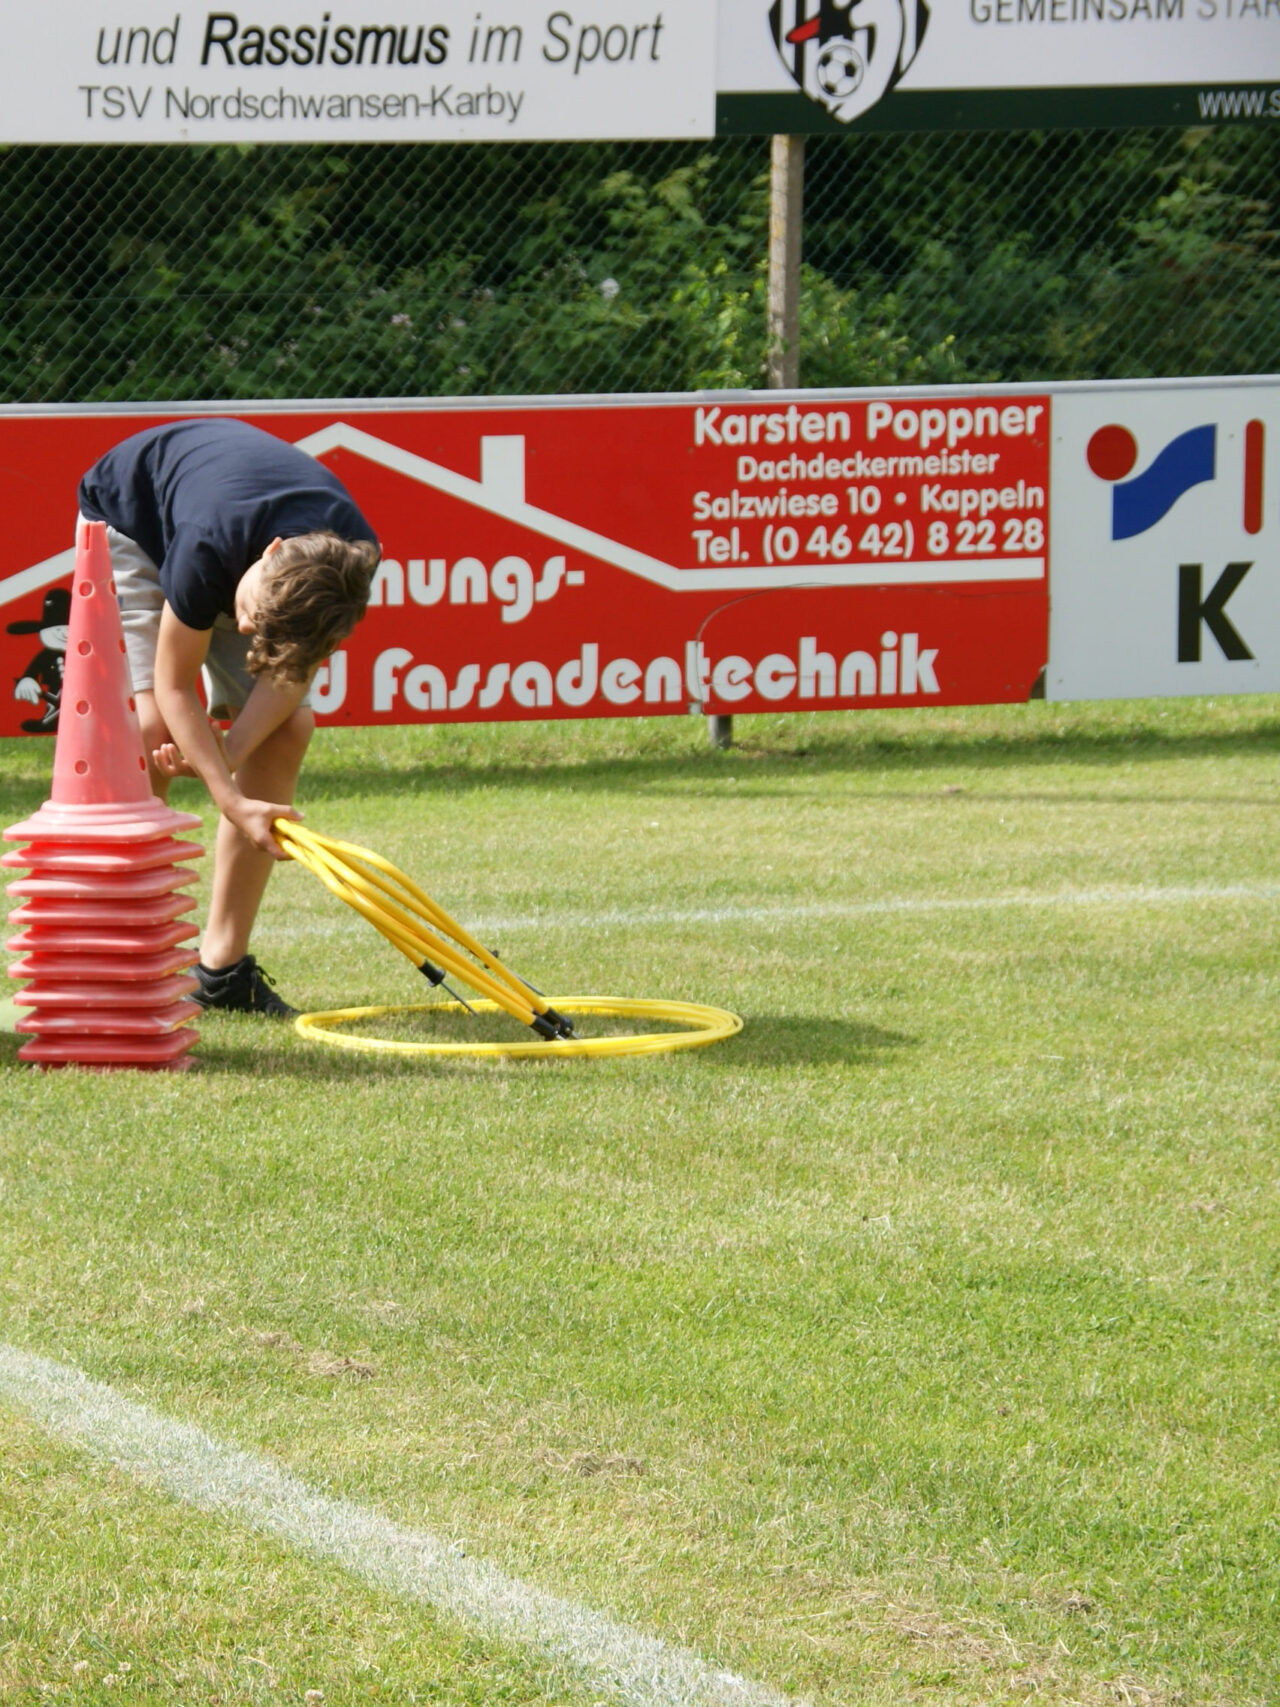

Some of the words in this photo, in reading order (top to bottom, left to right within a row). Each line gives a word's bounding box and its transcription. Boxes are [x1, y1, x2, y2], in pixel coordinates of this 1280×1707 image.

[96, 14, 181, 65] und
[200, 12, 450, 66] Rassismus
[468, 13, 523, 63] im
[542, 12, 665, 75] Sport
[78, 86, 153, 119] TSV
[164, 84, 525, 122] Nordschwansen-Karby
[693, 404, 851, 447] Karsten
[866, 402, 1044, 449] Poppner
[737, 447, 1001, 483] Dachdeckermeister
[692, 487, 839, 522] Salzwiese
[846, 485, 883, 516] 10
[920, 479, 1045, 519] Kappeln
[692, 526, 751, 564] Tel.
[763, 523, 800, 564] (0
[805, 523, 853, 559] 46
[858, 518, 916, 559] 42)
[926, 520, 951, 555] 8
[954, 517, 997, 554] 22
[1002, 516, 1046, 552] 28
[1177, 560, 1256, 663] K
[372, 630, 941, 713] Fassadentechnik
